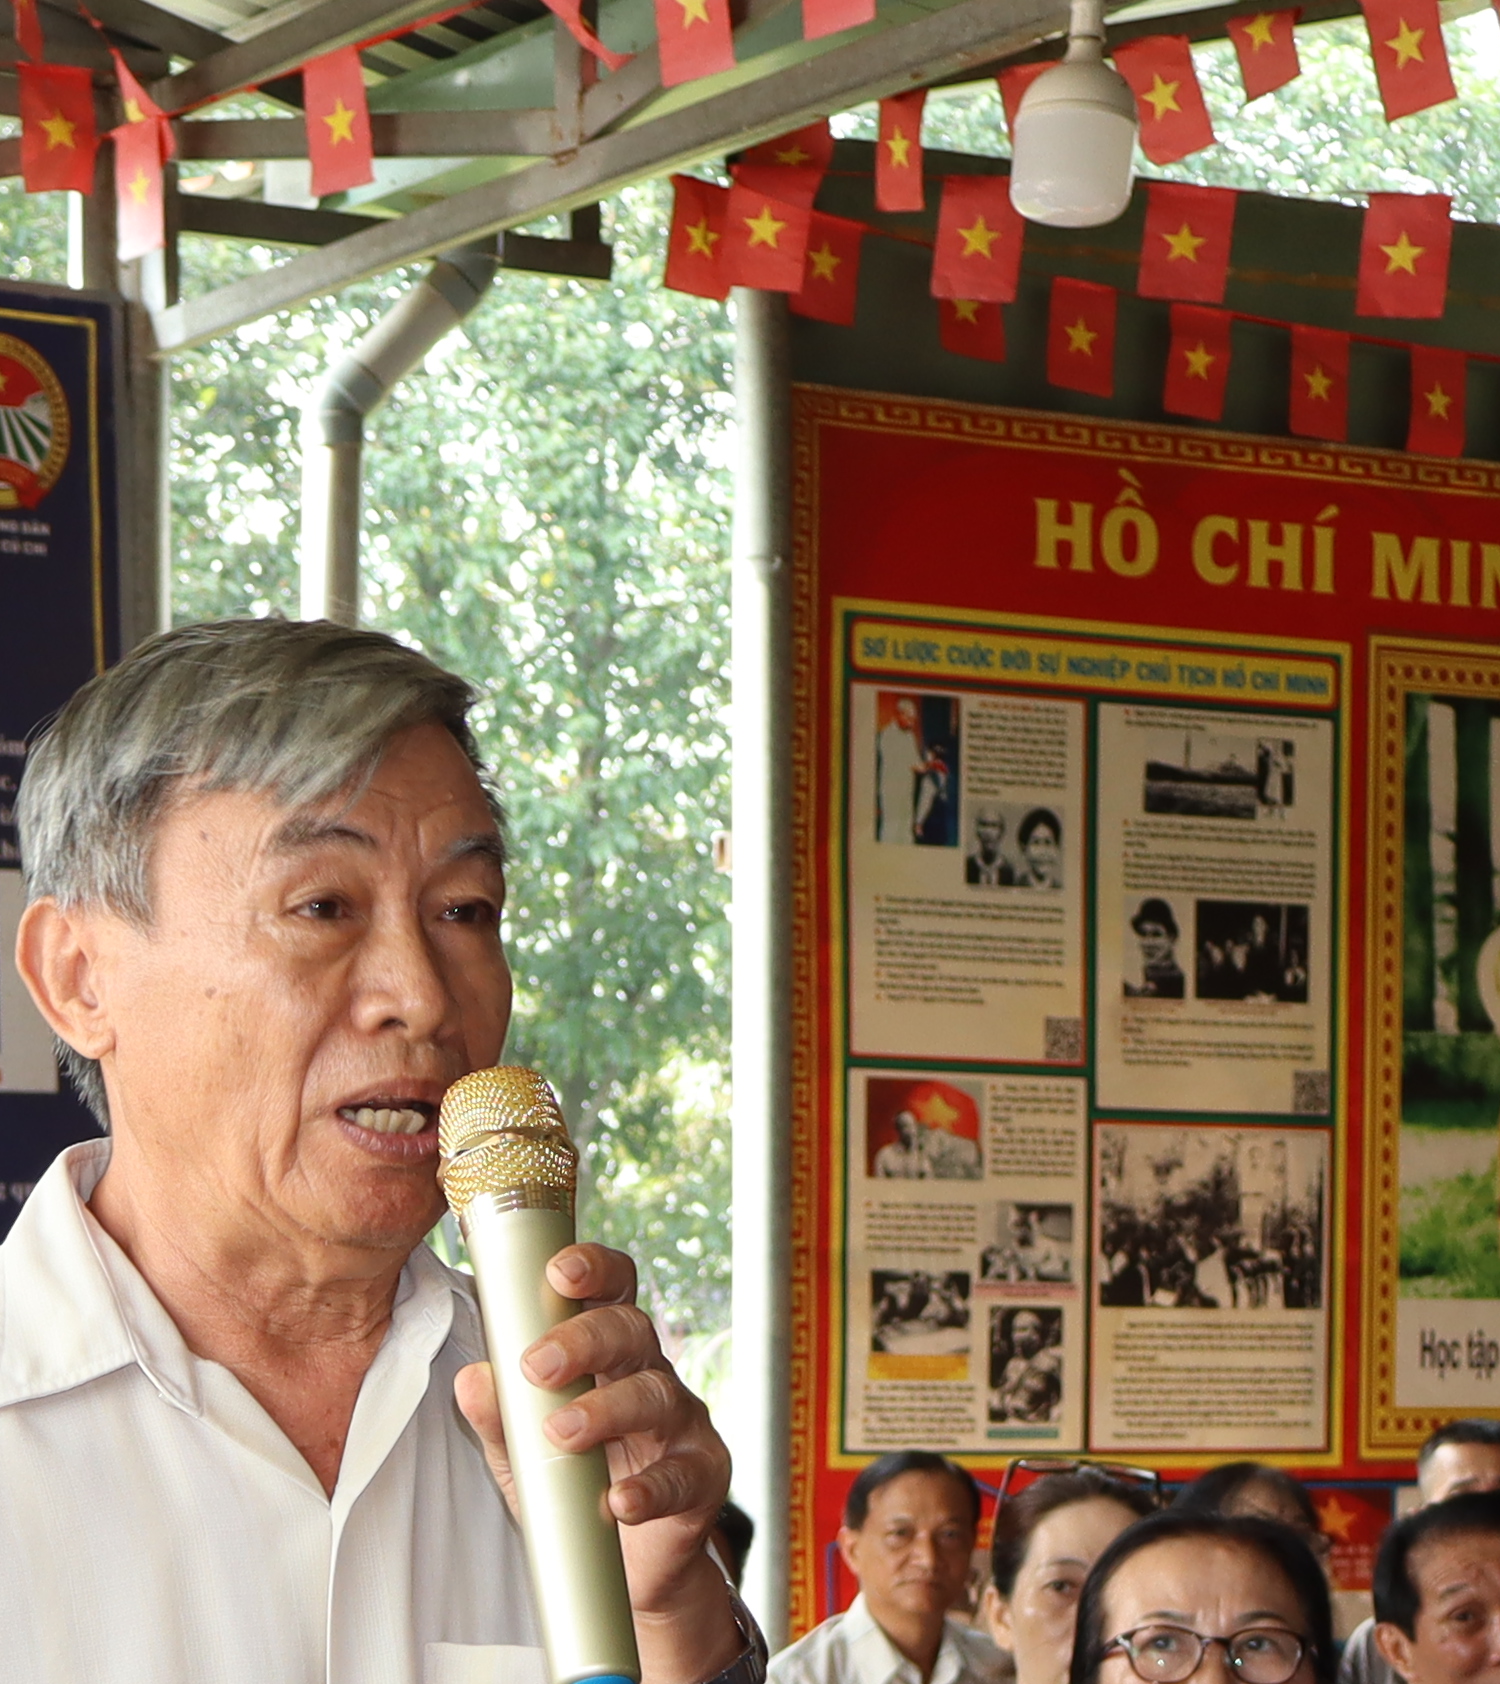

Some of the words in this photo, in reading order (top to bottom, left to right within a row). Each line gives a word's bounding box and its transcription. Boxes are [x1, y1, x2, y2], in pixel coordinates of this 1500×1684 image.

[1034, 468, 1160, 578] HỒ
[1191, 504, 1340, 595] CHÍ
[1420, 1328, 1461, 1380] Học
[1466, 1330, 1500, 1378] tập
